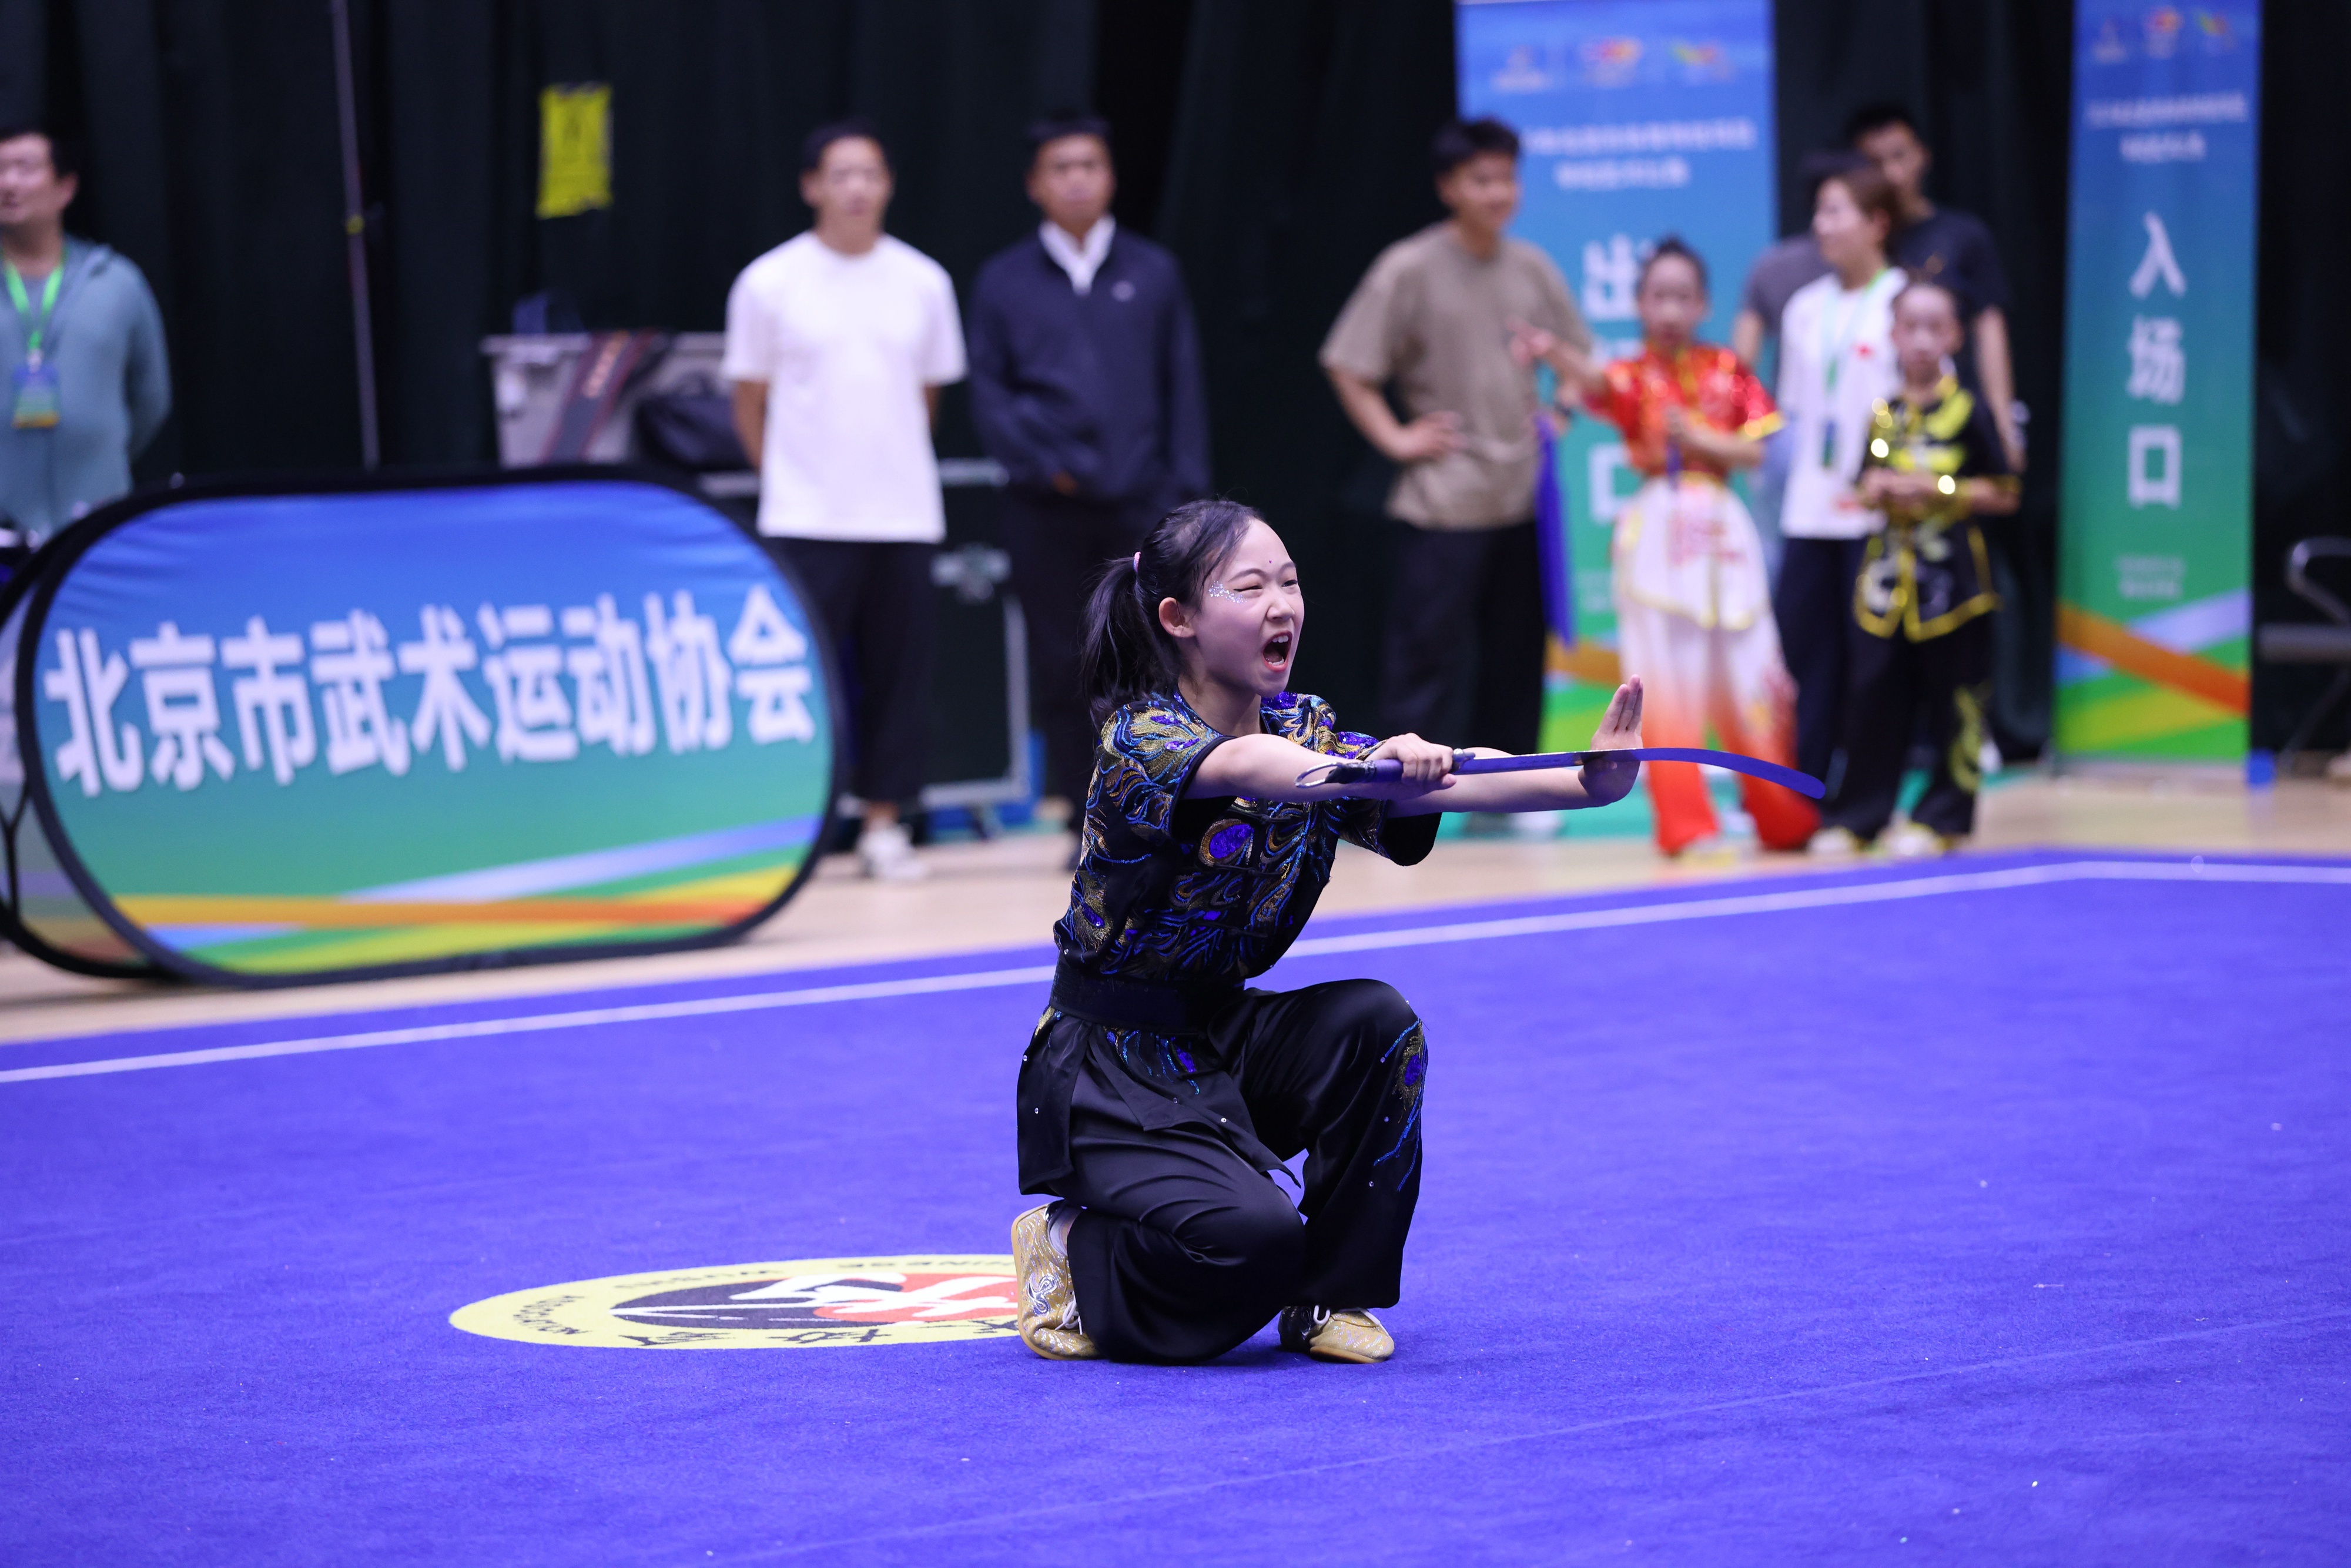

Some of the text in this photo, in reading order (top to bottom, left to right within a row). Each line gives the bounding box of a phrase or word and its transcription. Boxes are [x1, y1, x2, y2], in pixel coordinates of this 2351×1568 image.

[2127, 210, 2186, 509] 入场口
[43, 584, 817, 798] 北京市武术运动协会
